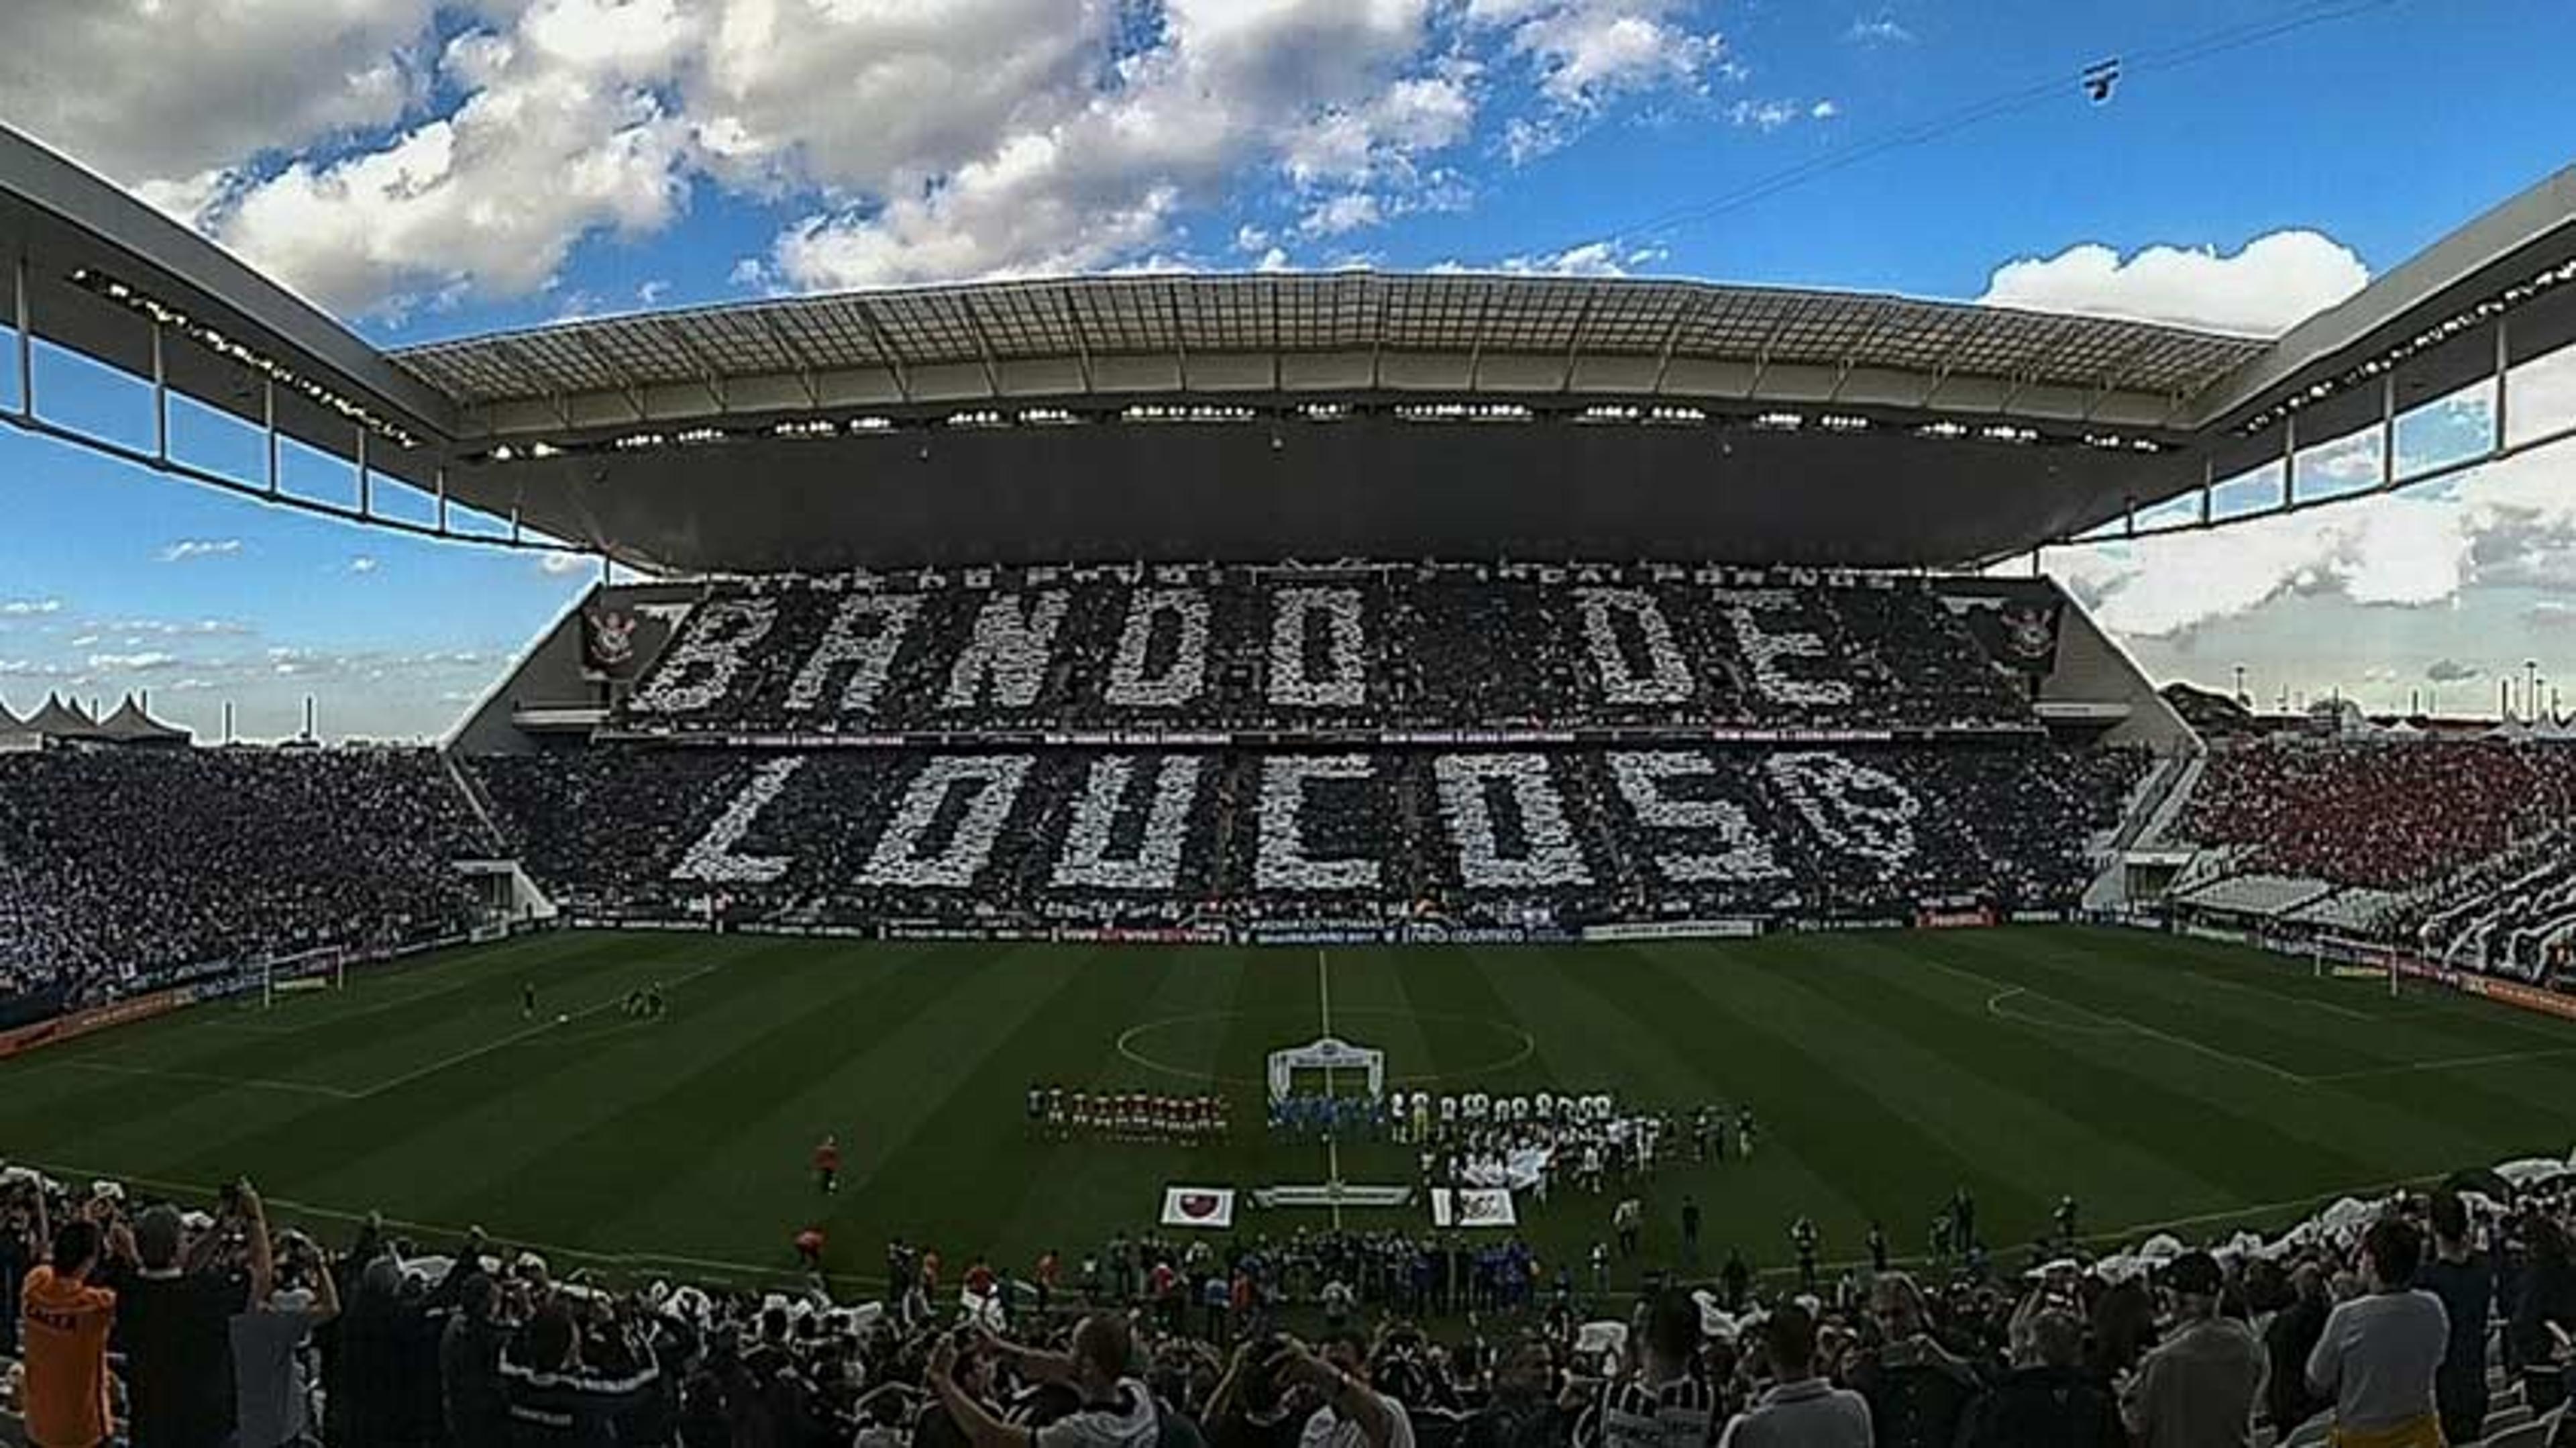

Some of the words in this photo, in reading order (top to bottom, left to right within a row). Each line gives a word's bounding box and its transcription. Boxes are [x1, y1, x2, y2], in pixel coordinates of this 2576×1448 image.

[628, 585, 1366, 713] BANDO
[1567, 585, 1853, 708] DE
[671, 752, 1792, 890] LOUCOS
